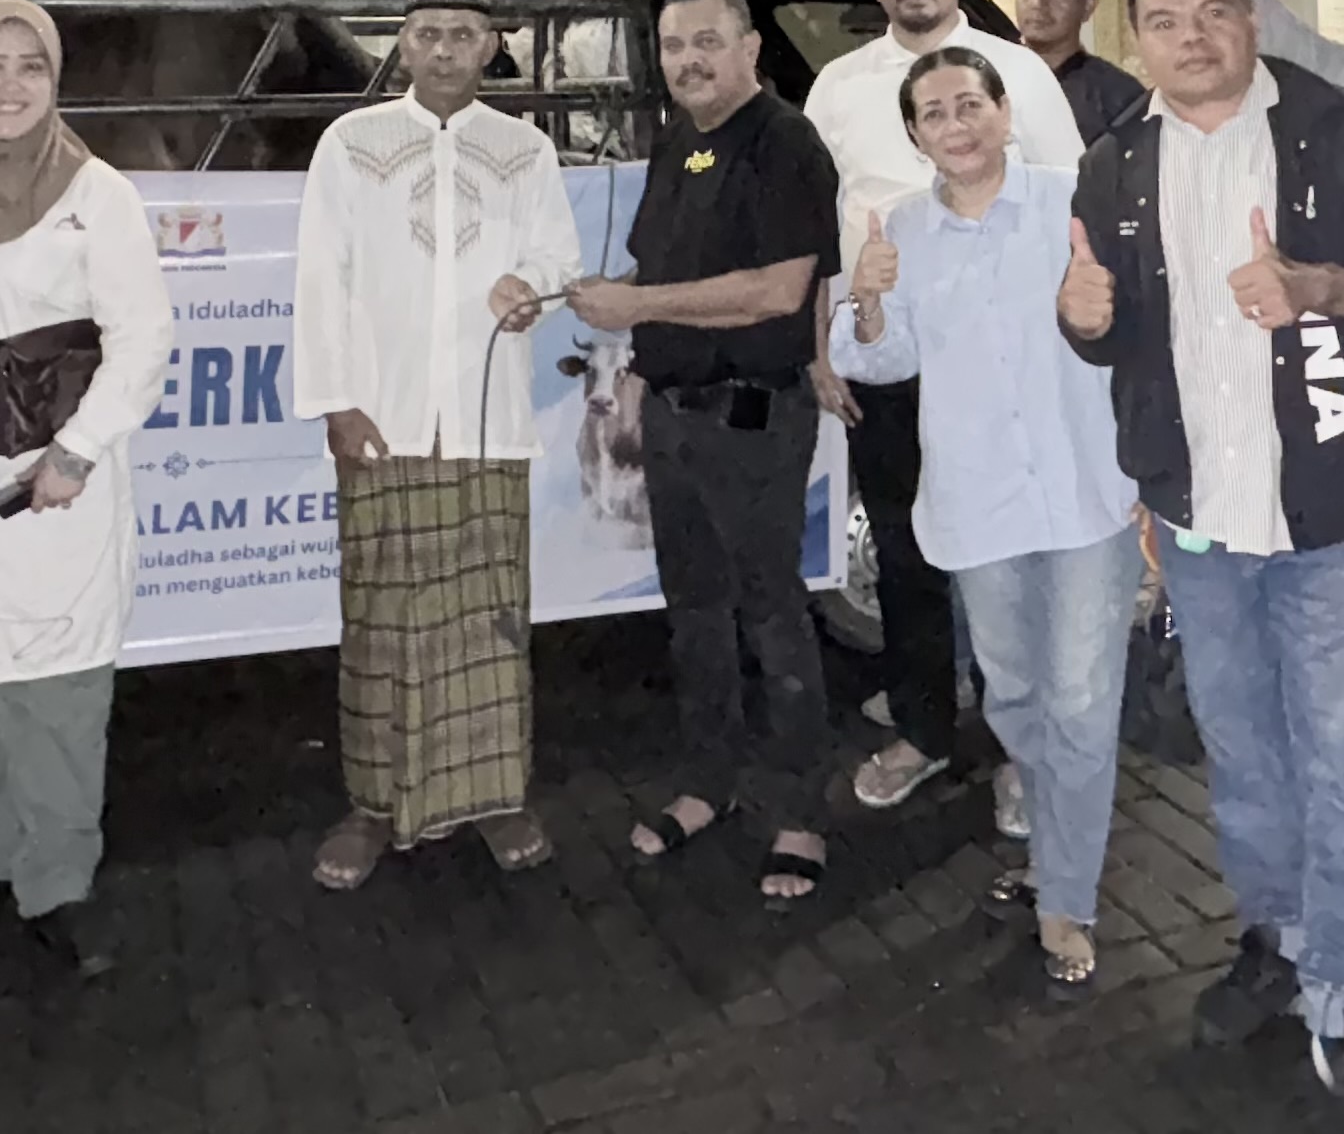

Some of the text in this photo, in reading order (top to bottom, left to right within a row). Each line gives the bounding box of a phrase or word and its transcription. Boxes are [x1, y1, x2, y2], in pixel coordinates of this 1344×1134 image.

[189, 298, 294, 320] Iduladha
[139, 549, 215, 569] uladha
[220, 539, 296, 562] sebagai
[167, 569, 291, 595] menguatkan
